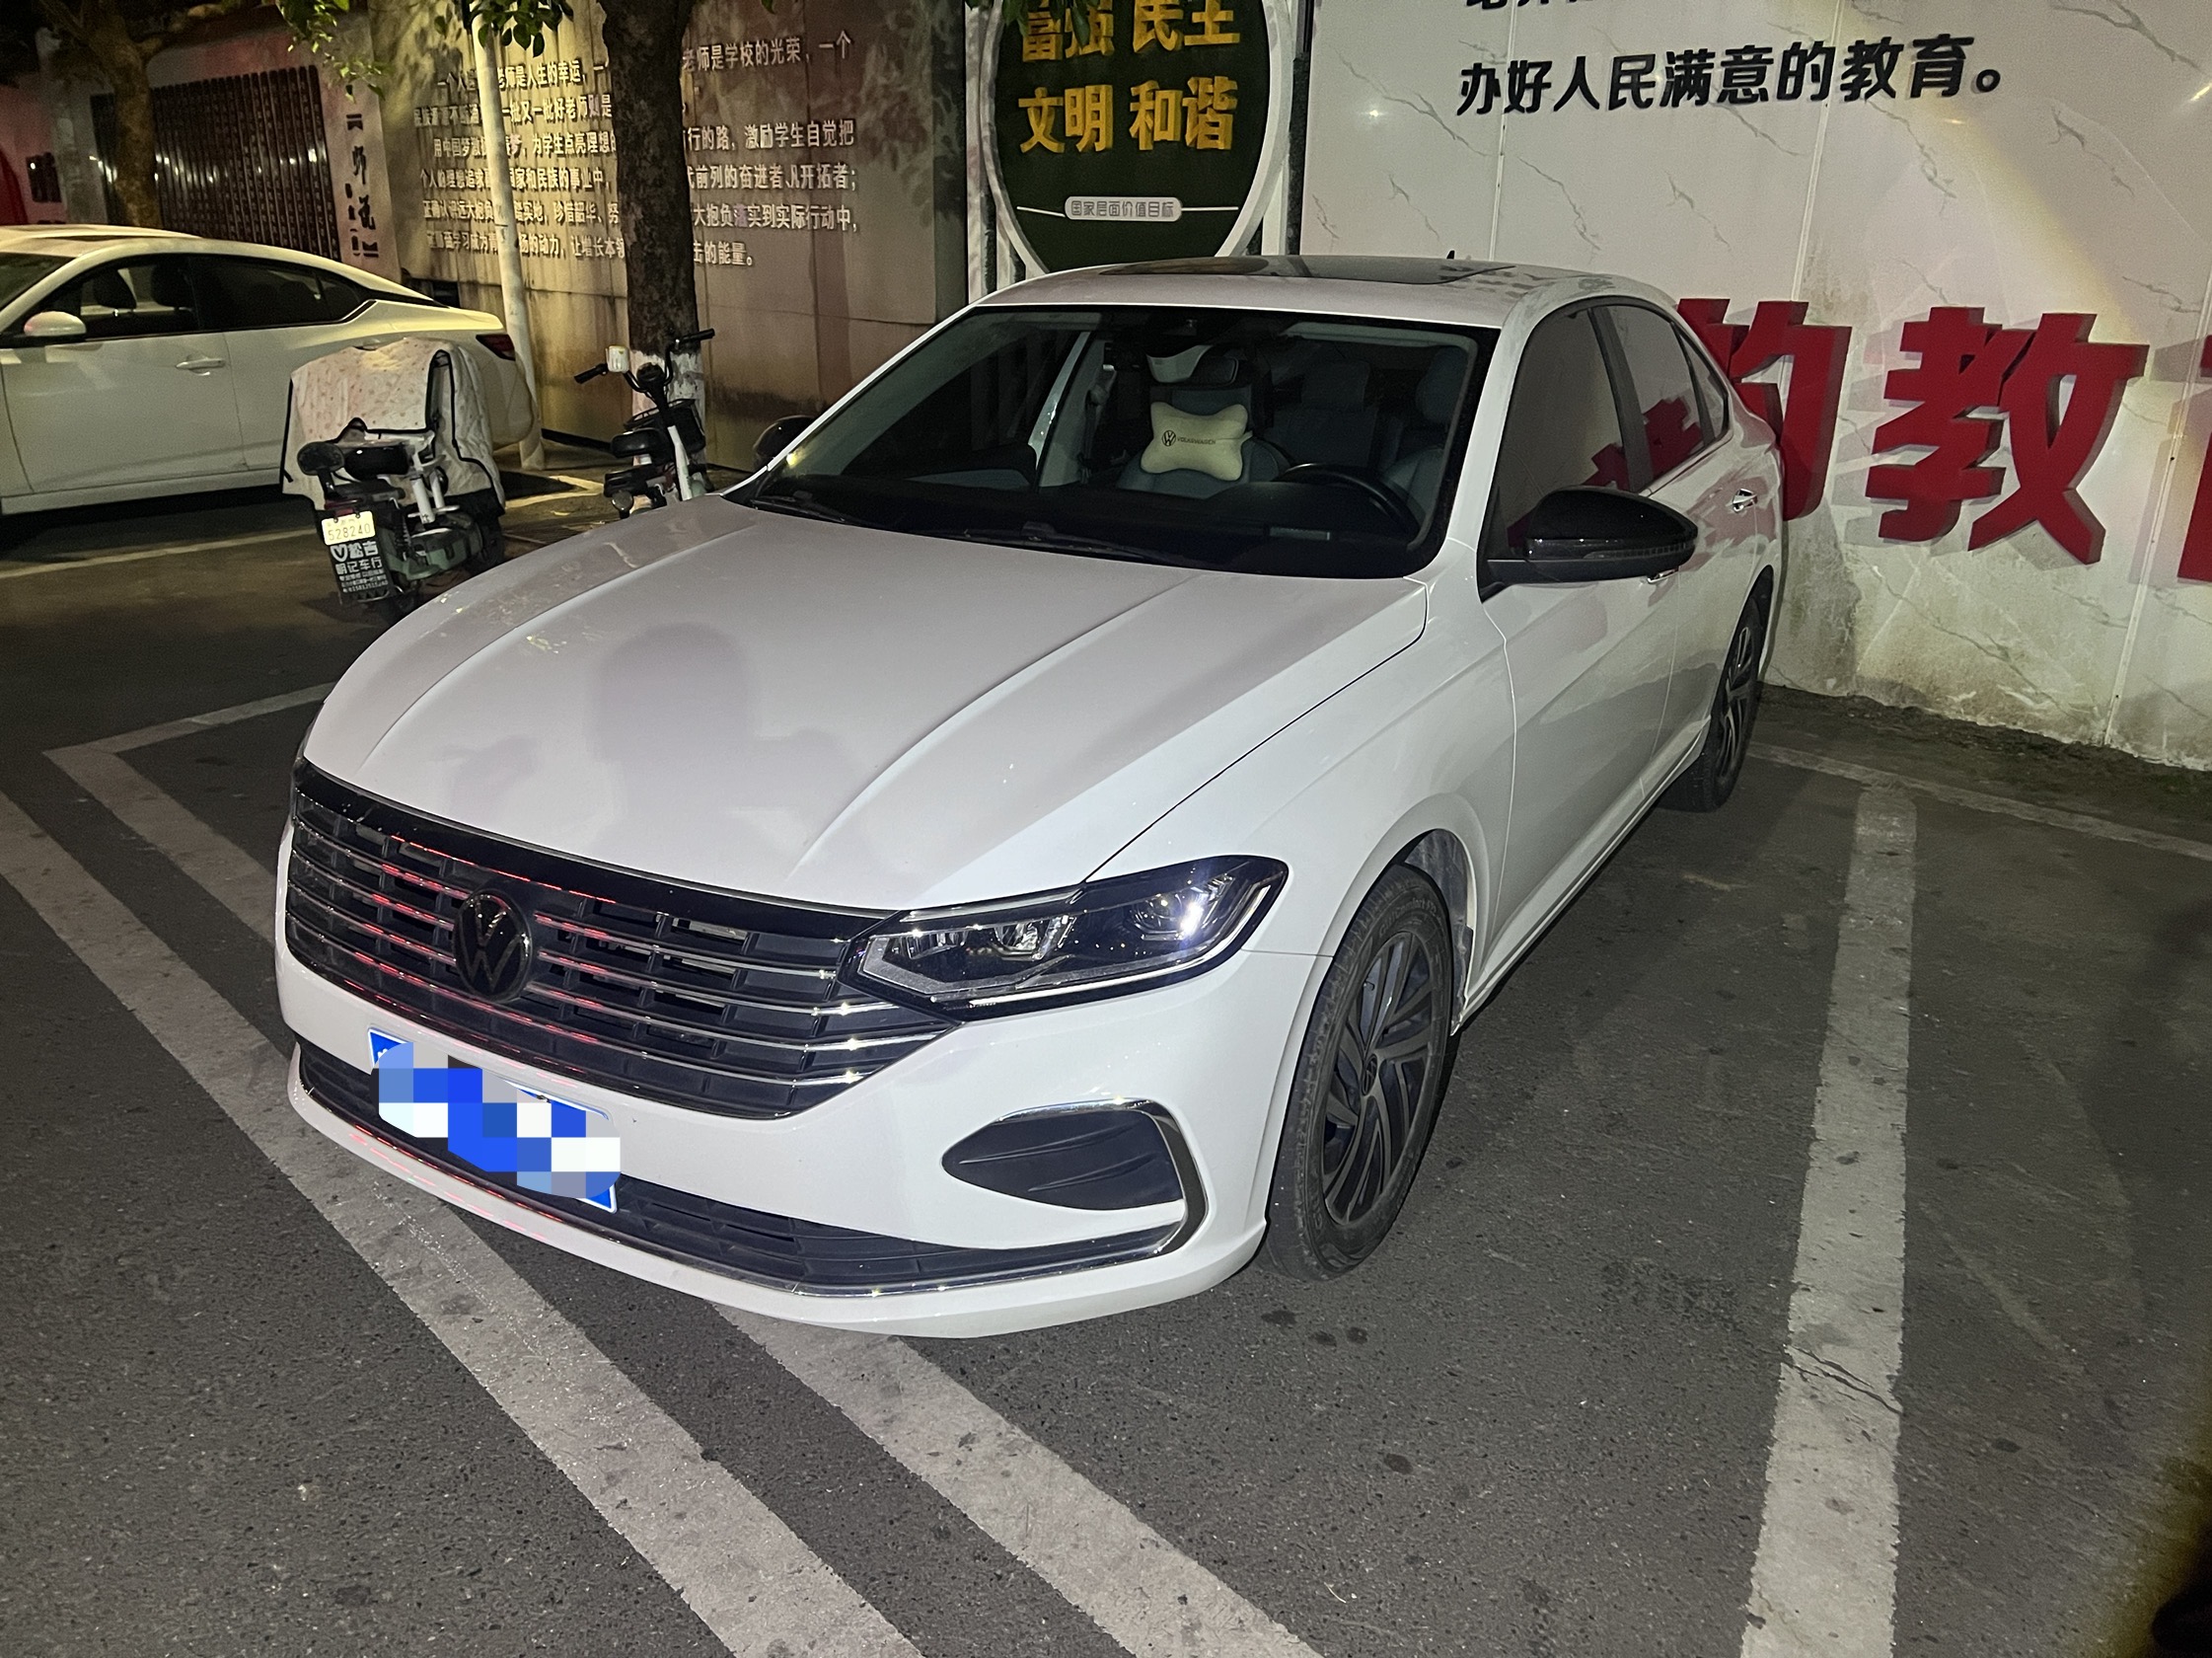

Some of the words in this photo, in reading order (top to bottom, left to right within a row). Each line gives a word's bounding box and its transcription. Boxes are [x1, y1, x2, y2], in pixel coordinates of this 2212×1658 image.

[1018, 85, 1114, 153] 文明
[1129, 75, 1238, 151] 和谐
[1456, 34, 2002, 116] 办好人民满意的教育。
[1070, 200, 1174, 218] 国家层面价值目标
